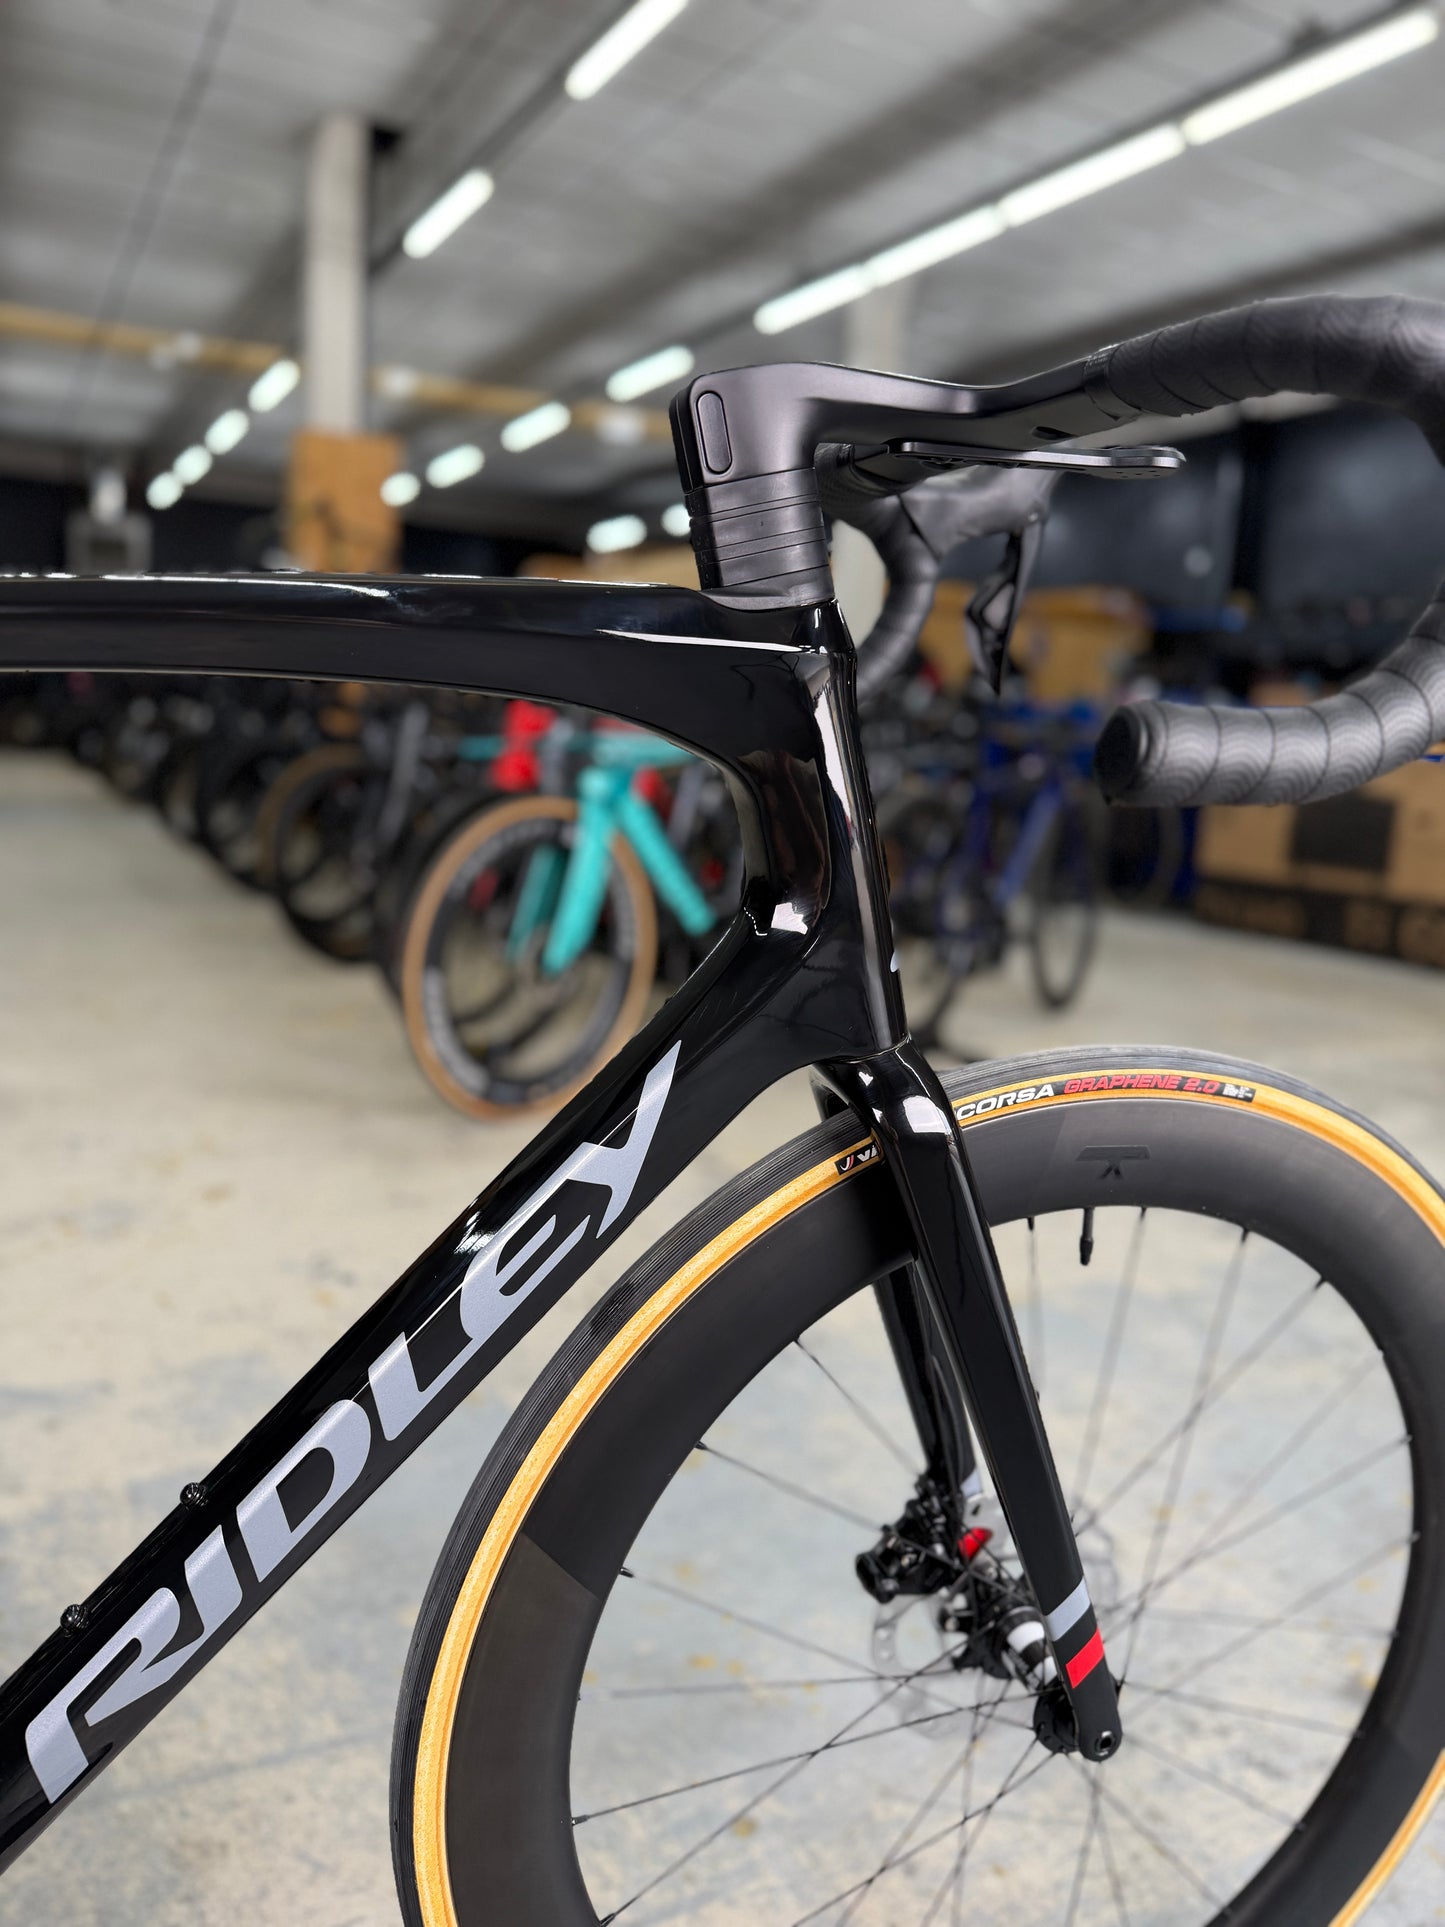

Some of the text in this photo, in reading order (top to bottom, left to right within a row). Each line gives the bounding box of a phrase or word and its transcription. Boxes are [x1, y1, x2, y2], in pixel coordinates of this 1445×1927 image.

[956, 1084, 1055, 1120] CORSA
[1064, 1074, 1181, 1094] GRAPHENE
[1183, 1078, 1220, 1094] 2.0
[26, 1040, 681, 1803] RIDLEY
